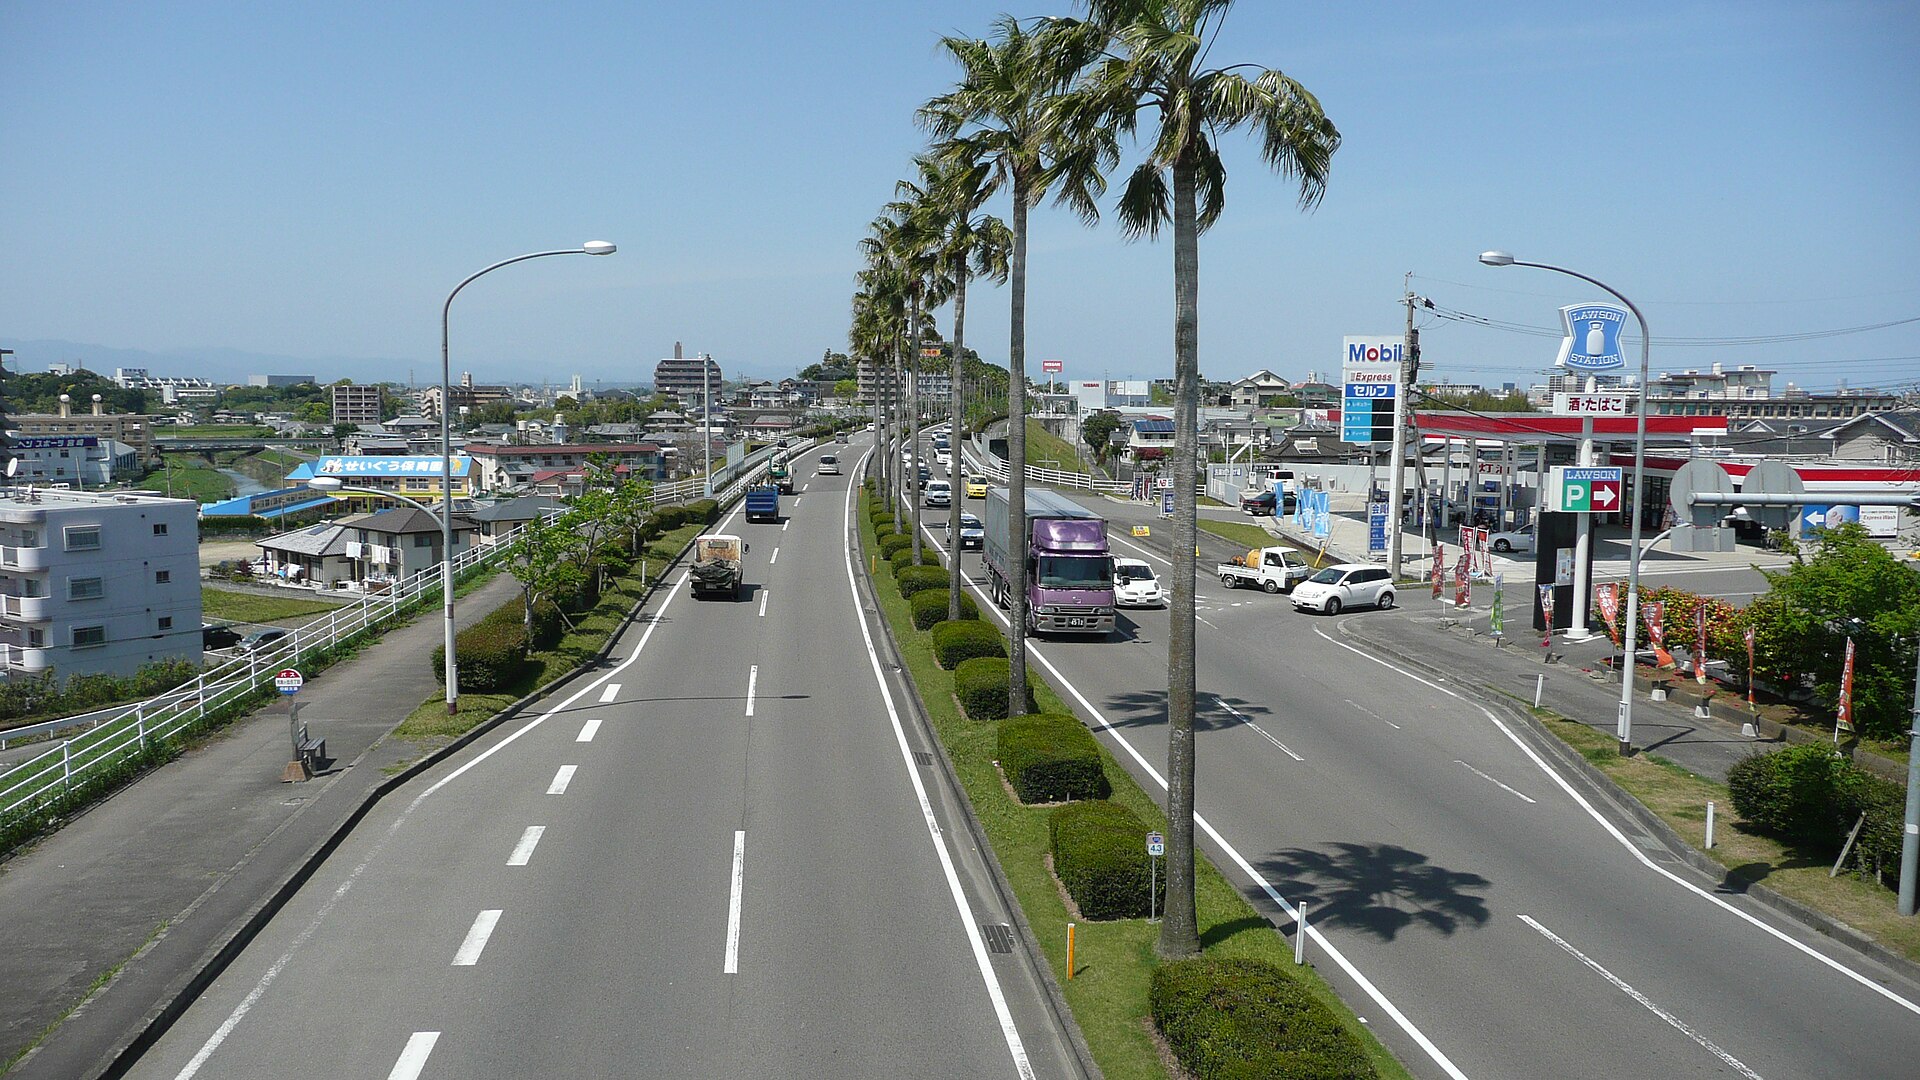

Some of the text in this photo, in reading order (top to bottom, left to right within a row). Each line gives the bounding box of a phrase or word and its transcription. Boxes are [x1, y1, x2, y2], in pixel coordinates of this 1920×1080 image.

[1572, 310, 1621, 322] LAWSON
[1348, 343, 1402, 362] Mobil
[1570, 353, 1619, 365] STATION
[1355, 372, 1392, 382] Express
[1353, 385, 1388, 396] セルフ
[344, 460, 443, 472] せいぐう保育園
[1566, 470, 1616, 480] LAWSON
[1566, 485, 1584, 508] P
[1150, 844, 1162, 852] 43
